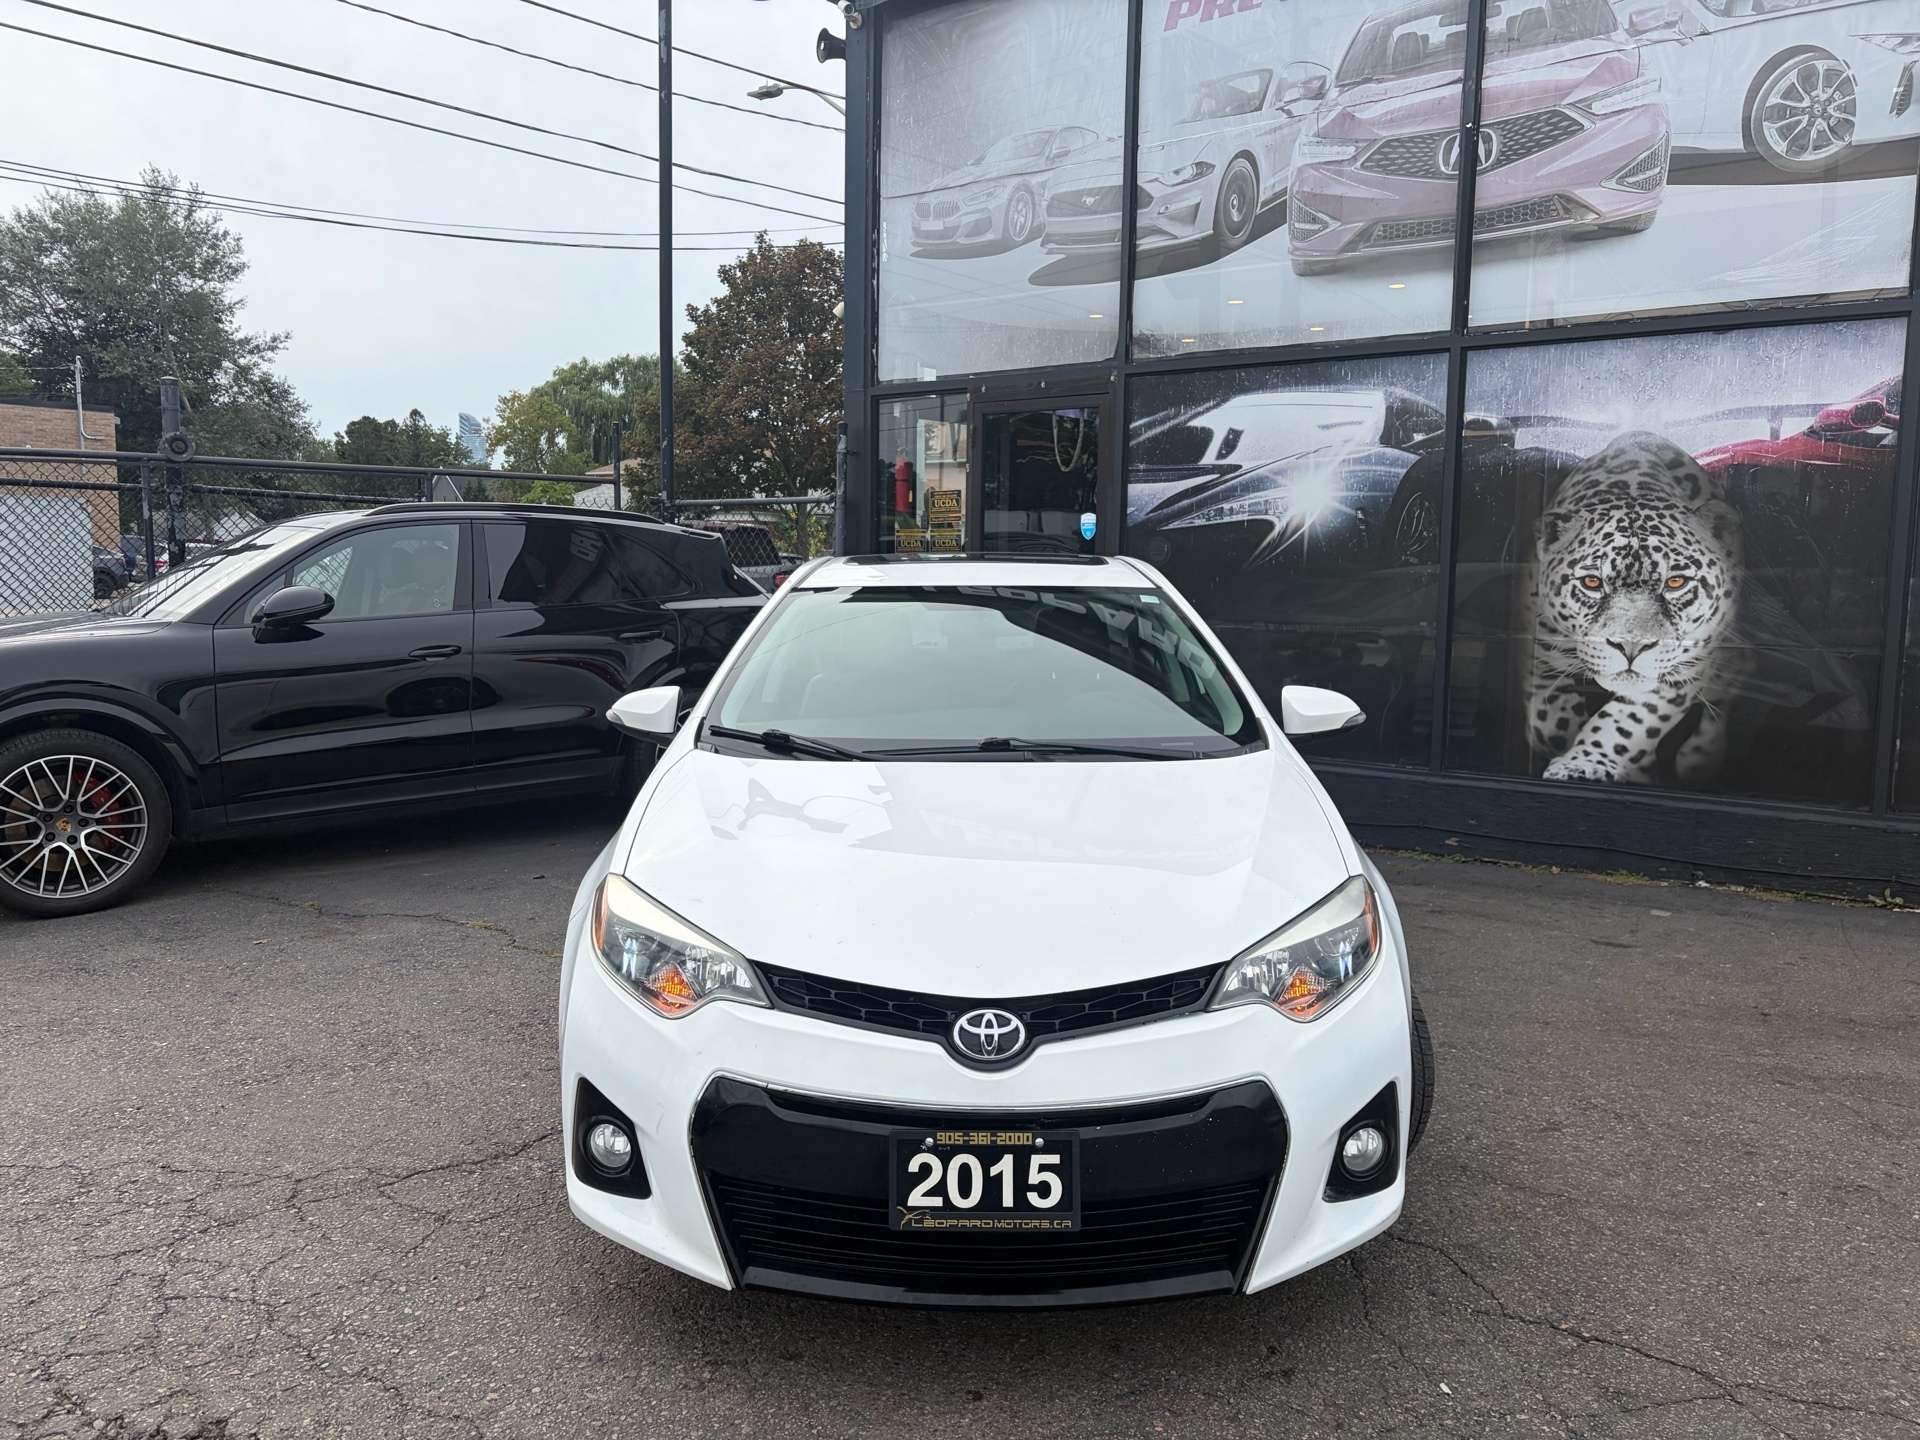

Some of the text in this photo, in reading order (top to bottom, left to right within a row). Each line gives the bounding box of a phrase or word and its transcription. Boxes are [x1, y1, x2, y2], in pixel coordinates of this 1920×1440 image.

[934, 499, 958, 507] UCDA
[935, 539, 957, 547] UCDA
[936, 1132, 1033, 1145] 905-361-2000
[907, 1152, 1063, 1209] 2015
